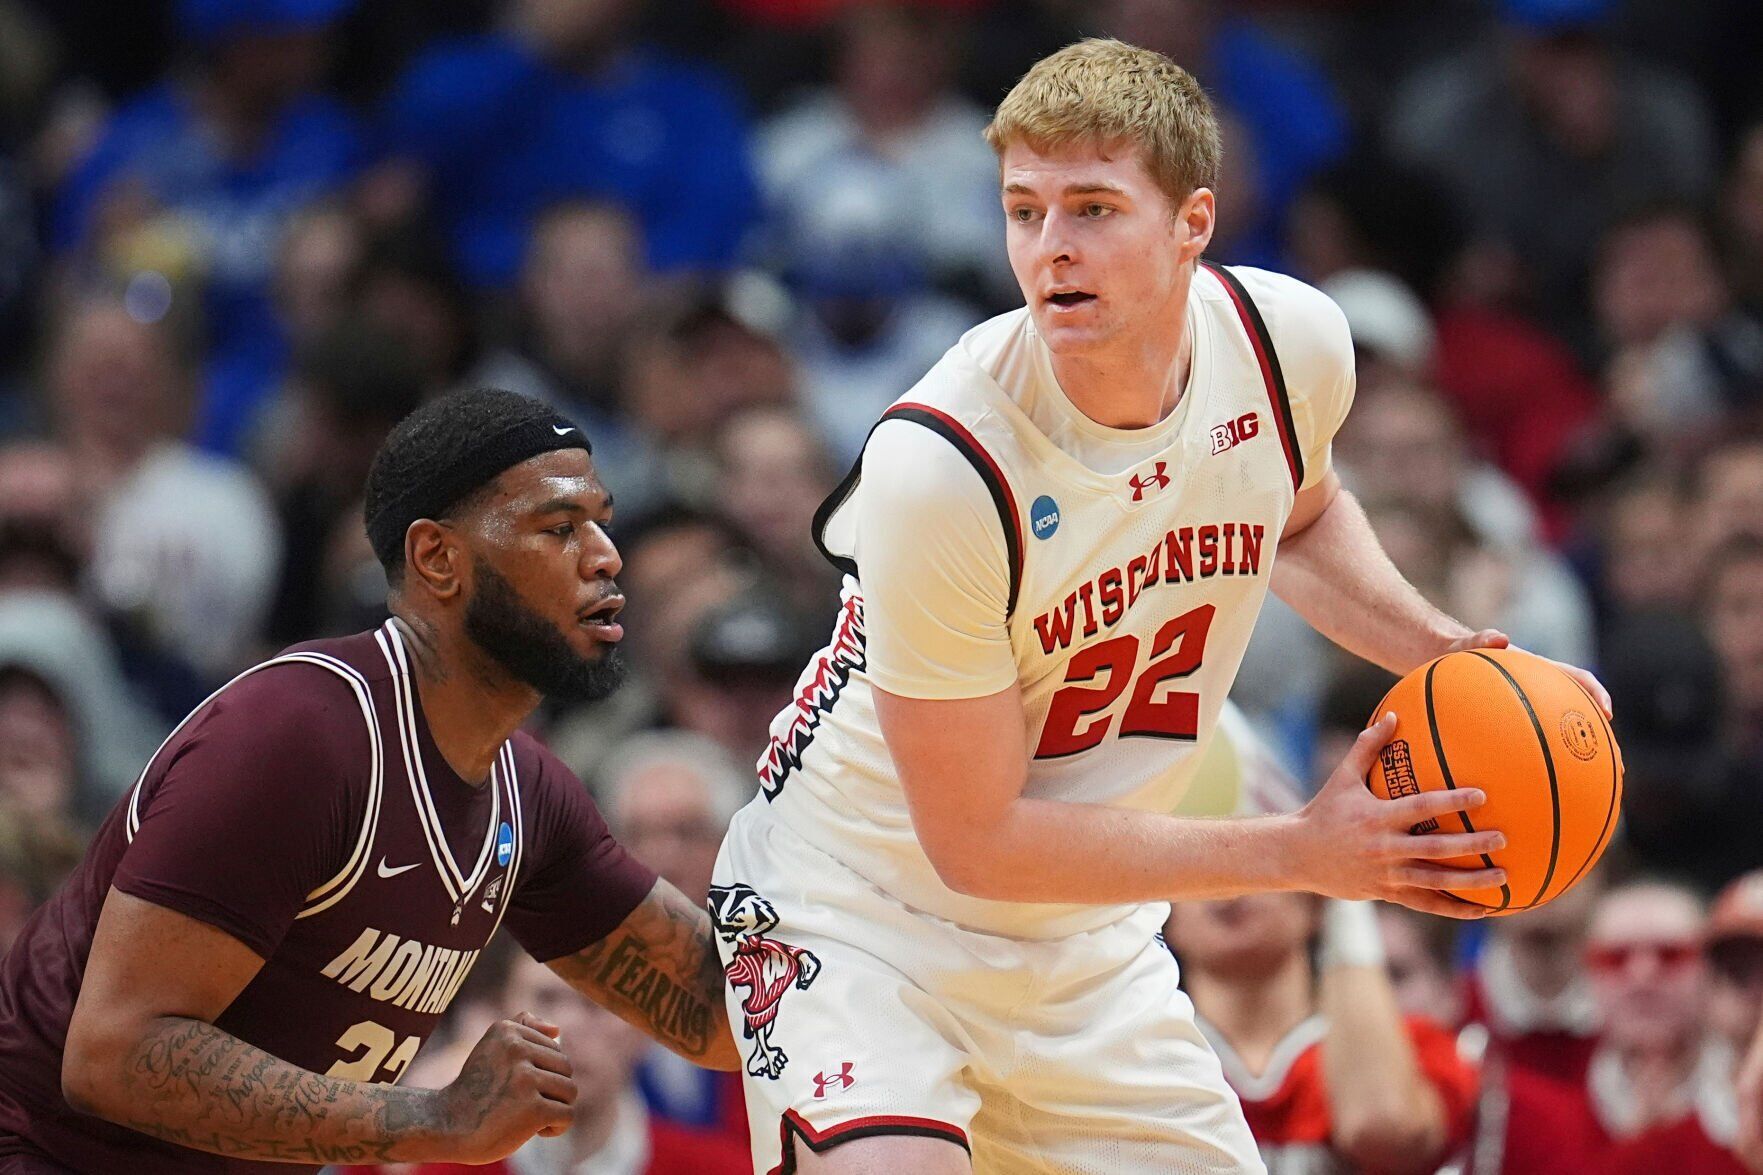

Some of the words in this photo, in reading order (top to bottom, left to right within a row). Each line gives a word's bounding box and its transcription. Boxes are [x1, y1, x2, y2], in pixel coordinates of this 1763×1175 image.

[1035, 512, 1059, 533] NCAA
[1033, 522, 1265, 656] WISCONSIN
[1033, 603, 1217, 760] 22
[1392, 741, 1415, 796] ADNESS
